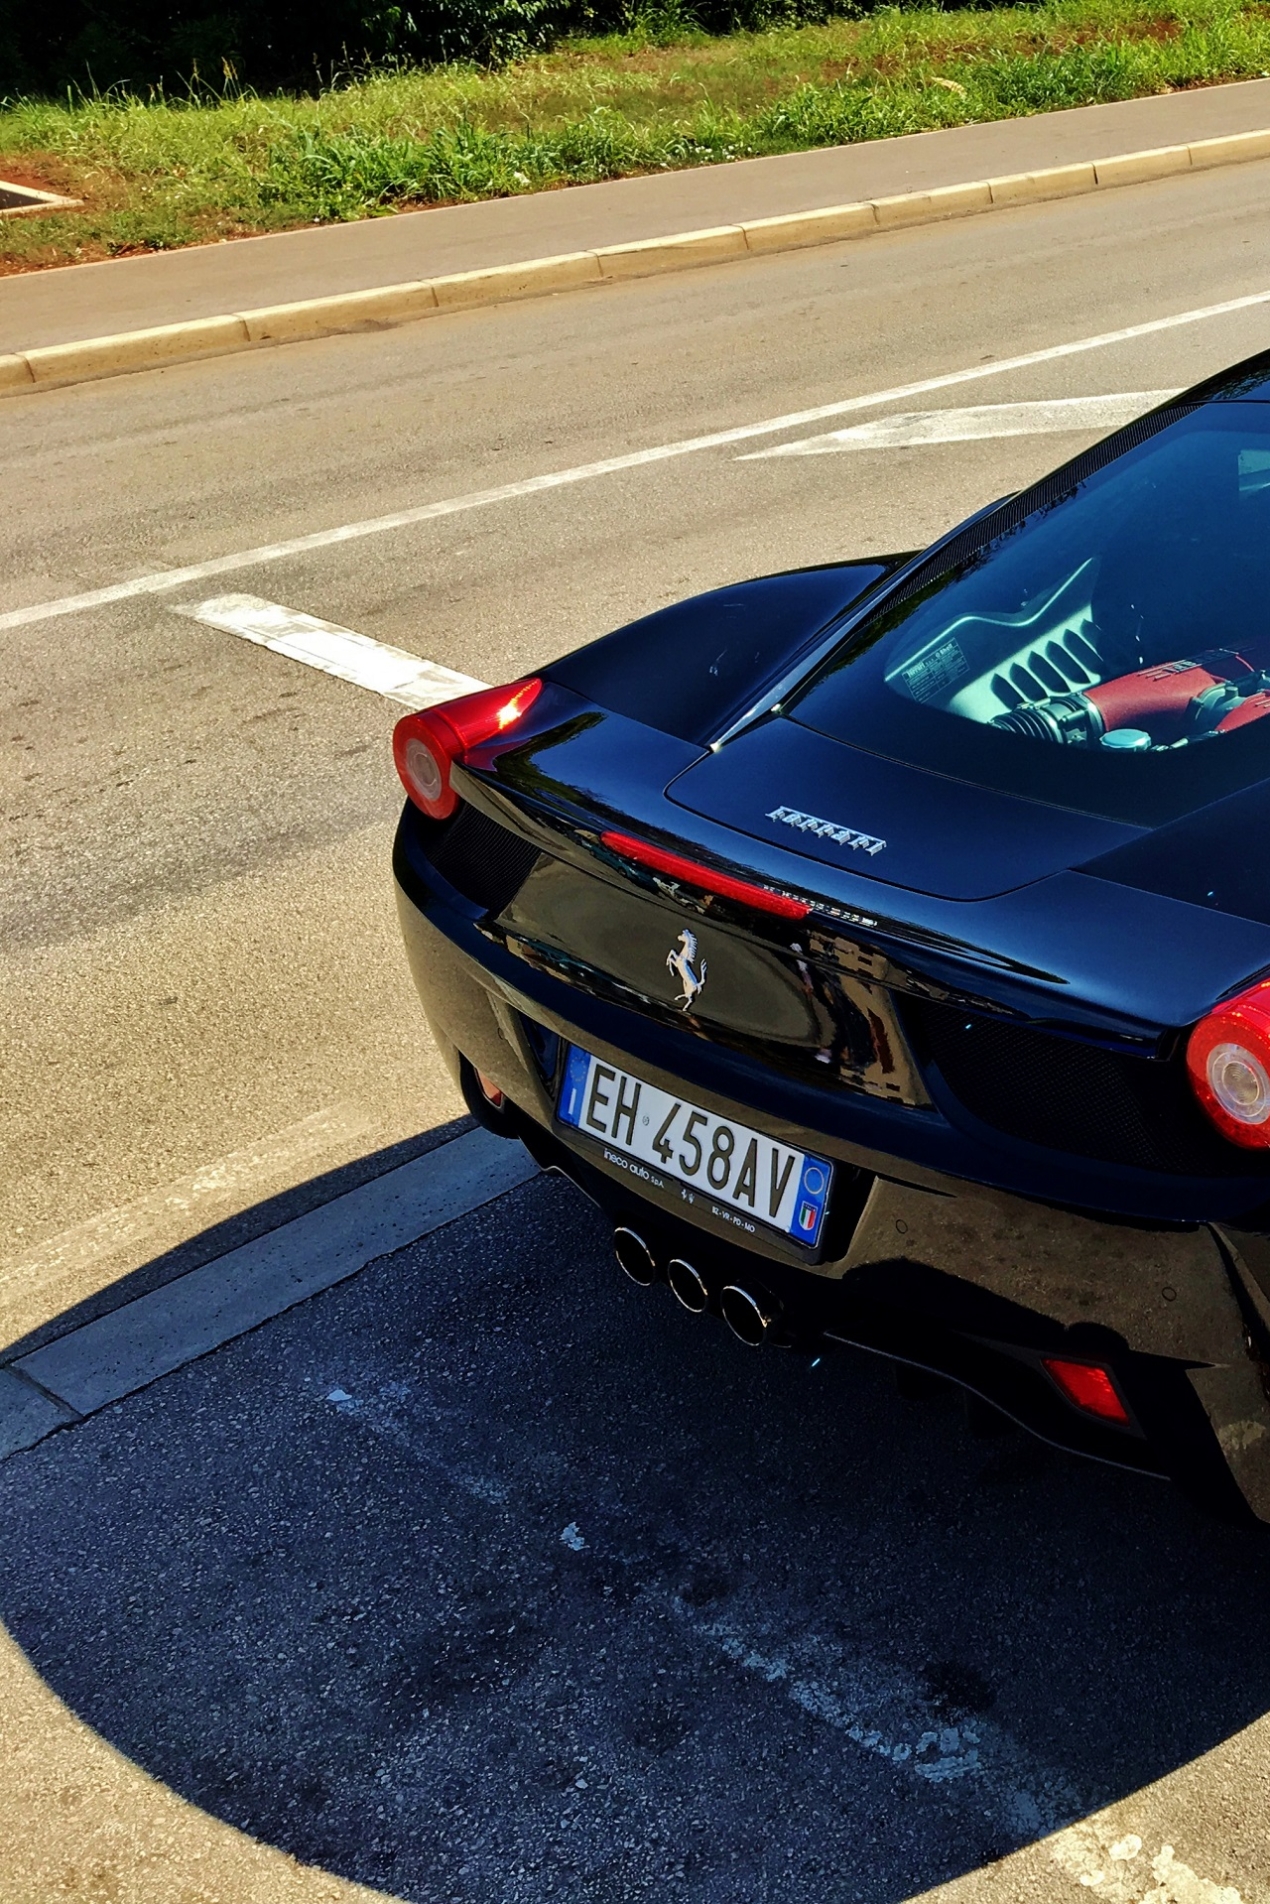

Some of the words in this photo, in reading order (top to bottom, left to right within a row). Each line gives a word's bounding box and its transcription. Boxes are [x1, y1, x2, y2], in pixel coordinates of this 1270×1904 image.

[765, 805, 887, 856] Ferrari
[586, 1063, 642, 1146] EH
[652, 1102, 796, 1219] 458AV
[603, 1148, 629, 1169] ineco
[629, 1163, 650, 1180] auto
